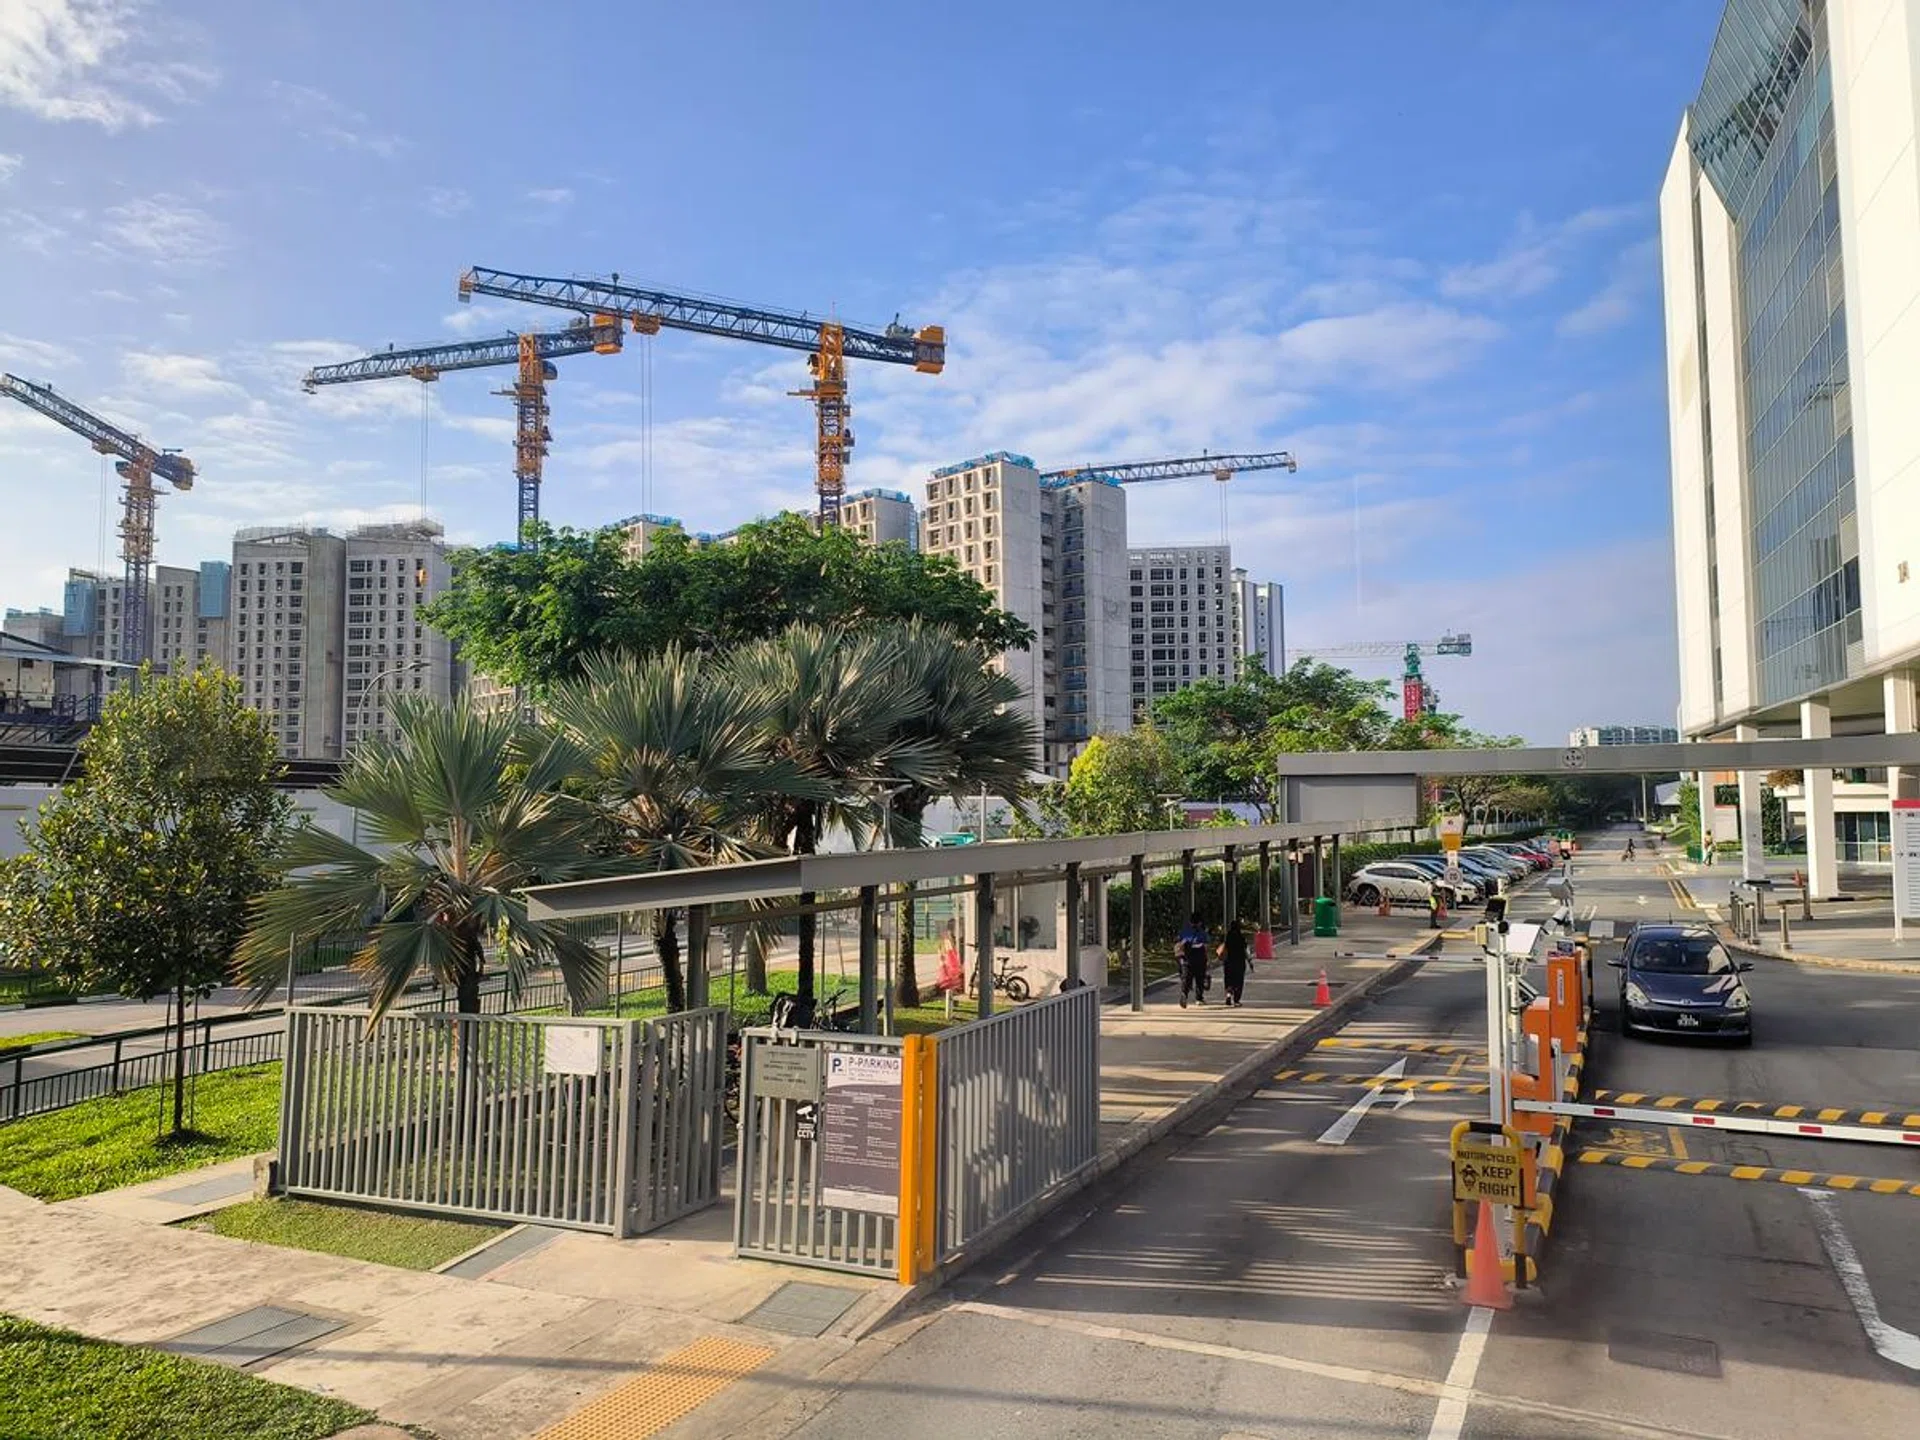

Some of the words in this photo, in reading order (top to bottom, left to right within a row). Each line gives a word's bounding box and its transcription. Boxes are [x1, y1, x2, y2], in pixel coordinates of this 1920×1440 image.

[849, 1056, 899, 1070] P-PARKING
[797, 1129, 815, 1139] CCTV
[1457, 1151, 1516, 1164] MOTORCYCLES
[1481, 1165, 1513, 1179] KEEP
[1479, 1182, 1517, 1197] RIGHT
